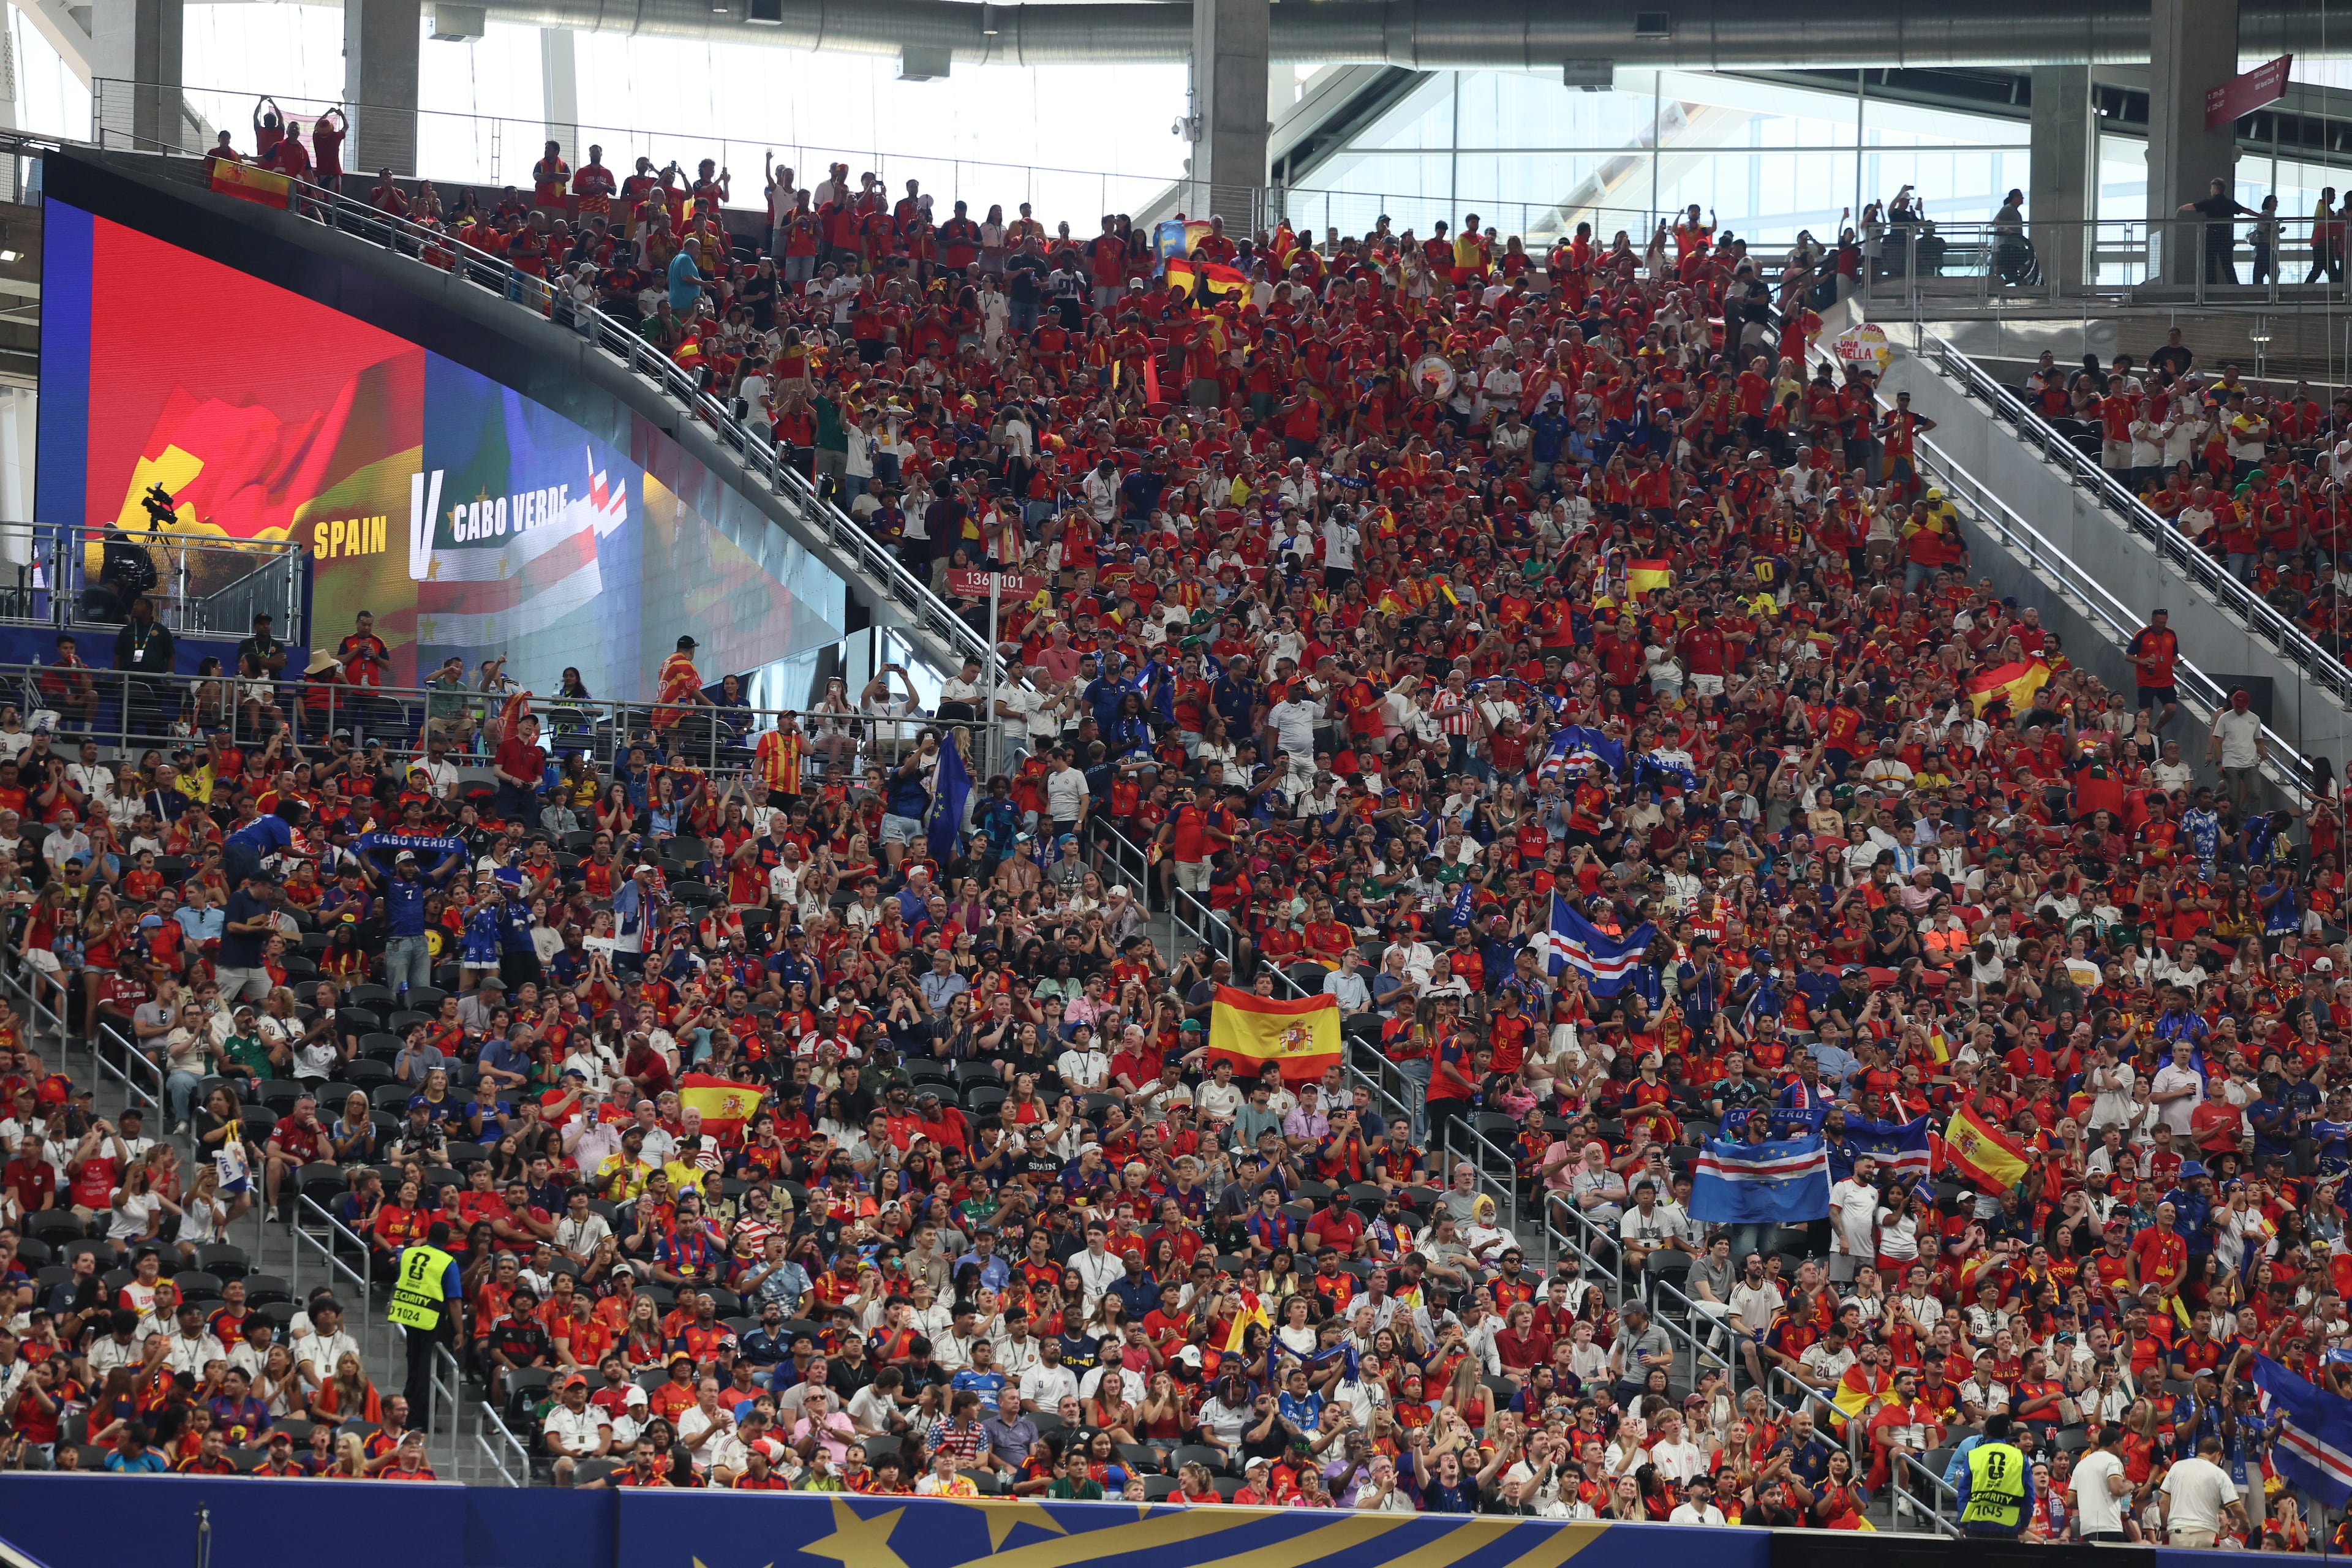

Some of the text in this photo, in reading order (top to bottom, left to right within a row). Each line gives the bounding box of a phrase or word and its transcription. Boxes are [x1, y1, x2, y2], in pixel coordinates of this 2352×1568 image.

[453, 483, 570, 543] CABO VERDE
[409, 469, 444, 581] V
[314, 516, 386, 560] SPAIN
[967, 572, 989, 586] 136
[1754, 562, 1774, 584] 10
[1001, 575, 1022, 589] 101
[1147, 633, 1155, 641] 21
[1351, 697, 1360, 707] 19
[1831, 717, 1845, 737] 9
[1085, 763, 1107, 777] MESSI
[1654, 758, 1683, 772] VERD
[374, 834, 456, 849] CABO VERDE
[780, 877, 790, 888] 14
[405, 889, 413, 900] 7
[1667, 886, 1676, 896] 19
[807, 903, 816, 914] 19
[1458, 895, 1471, 921] ABO
[1694, 927, 1720, 939] SPAIN
[1499, 1036, 1508, 1049] 19
[1730, 1110, 1814, 1123] CA VERDE
[1028, 1162, 1057, 1172] SPAIN
[569, 1238, 576, 1251] 7
[394, 1290, 431, 1306] ECURITY
[1336, 1287, 1344, 1298] 9
[1159, 1327, 1166, 1340] 7
[1973, 1323, 1983, 1334] 19
[1817, 1366, 1830, 1378] 20
[1411, 1417, 1422, 1427] 19
[1970, 1492, 2013, 1505] SECURITY
